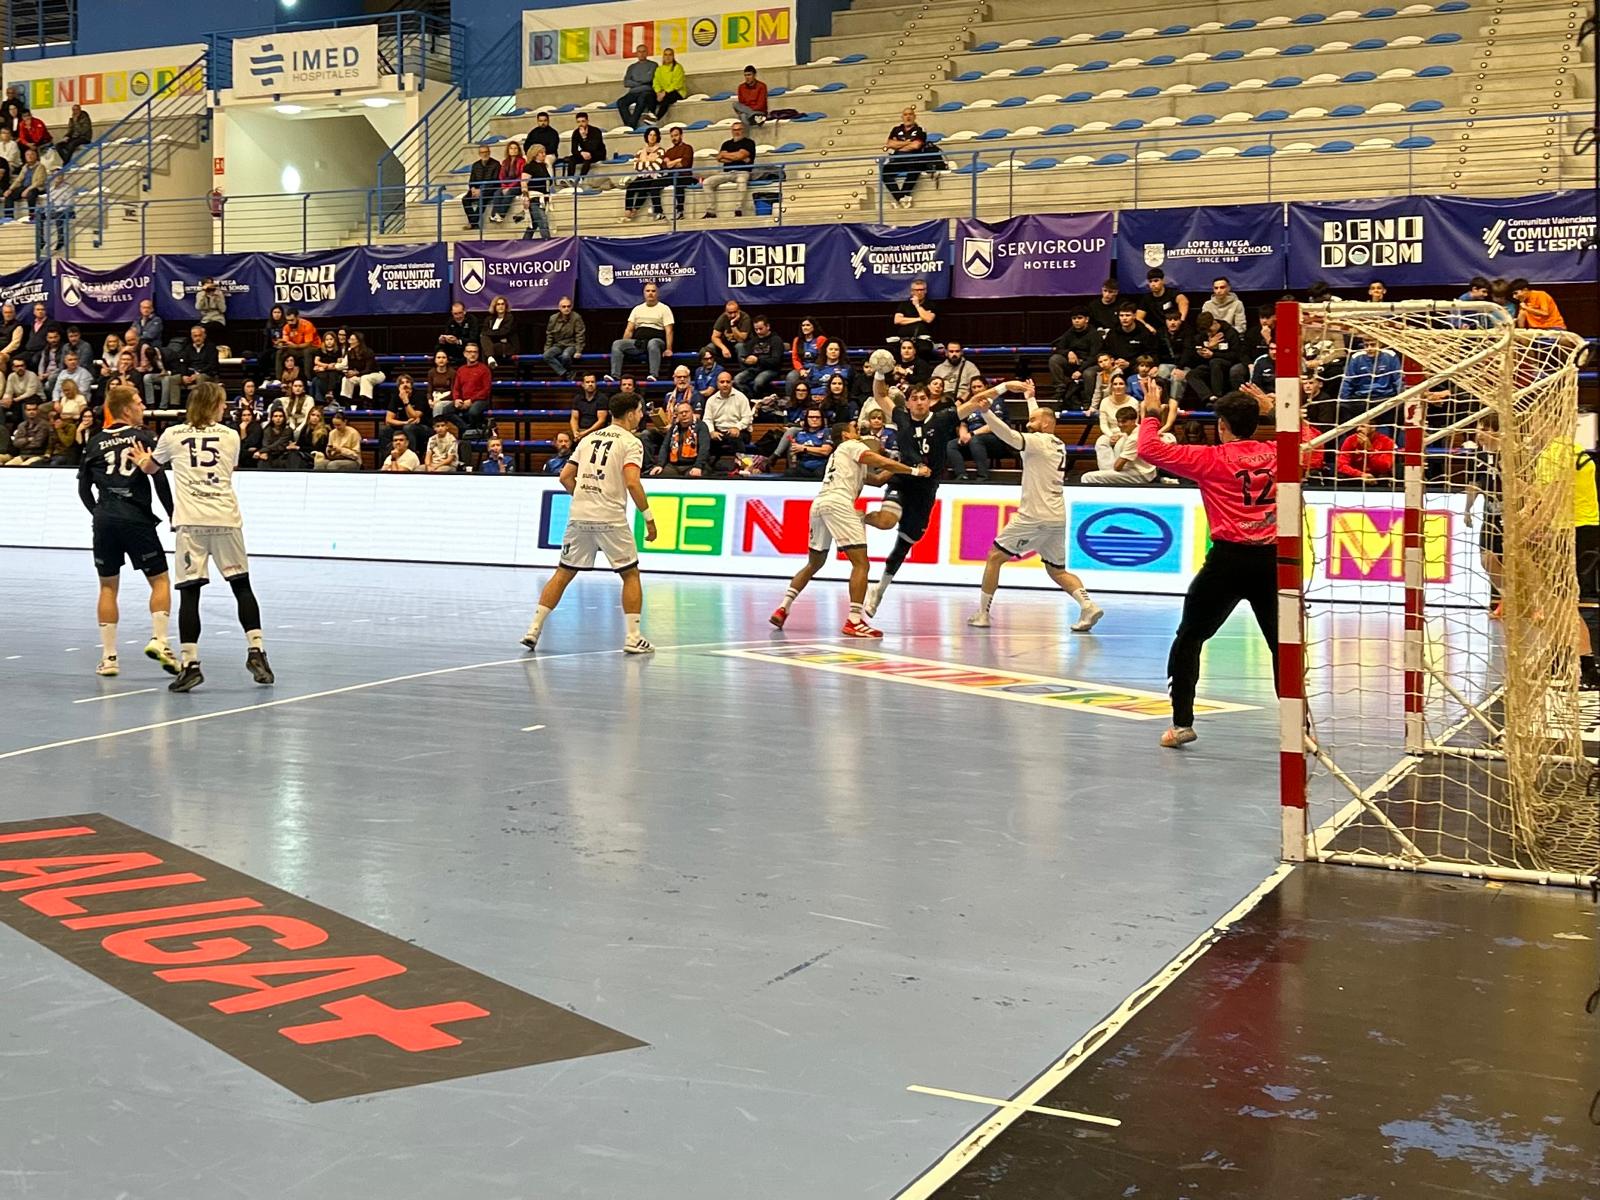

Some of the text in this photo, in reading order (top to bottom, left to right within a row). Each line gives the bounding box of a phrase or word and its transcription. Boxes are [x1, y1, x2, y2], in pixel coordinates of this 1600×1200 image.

[534, 11, 788, 62] BENIDORM
[293, 46, 359, 71] IMED
[292, 68, 360, 81] HOSPITALES
[1323, 216, 1423, 242] BENI
[1508, 216, 1596, 226] Comunitat Valenciana
[1507, 225, 1597, 240] COMUNITAT
[997, 238, 1106, 257] SERVIGROUP
[1167, 245, 1273, 256] INTERNATIONAL SCHOOL
[1212, 240, 1224, 248] DE
[1514, 240, 1535, 252] DE
[729, 243, 805, 265] BENI
[868, 250, 936, 263] COMUNITAT
[1320, 242, 1423, 268] DORM
[488, 259, 570, 275] SERVIGROUP
[873, 261, 944, 274] DE L'ESPORT
[1023, 260, 1076, 269] HOTELES
[275, 264, 336, 284] BENI
[382, 269, 435, 280] COMUNITAT
[728, 265, 805, 287] DORM
[386, 279, 442, 290] DE L'ESPORT
[509, 278, 549, 287] HOTELES
[275, 283, 336, 303] DORM
[180, 437, 220, 468] 15
[590, 439, 613, 466] 11
[1234, 468, 1277, 506] 12
